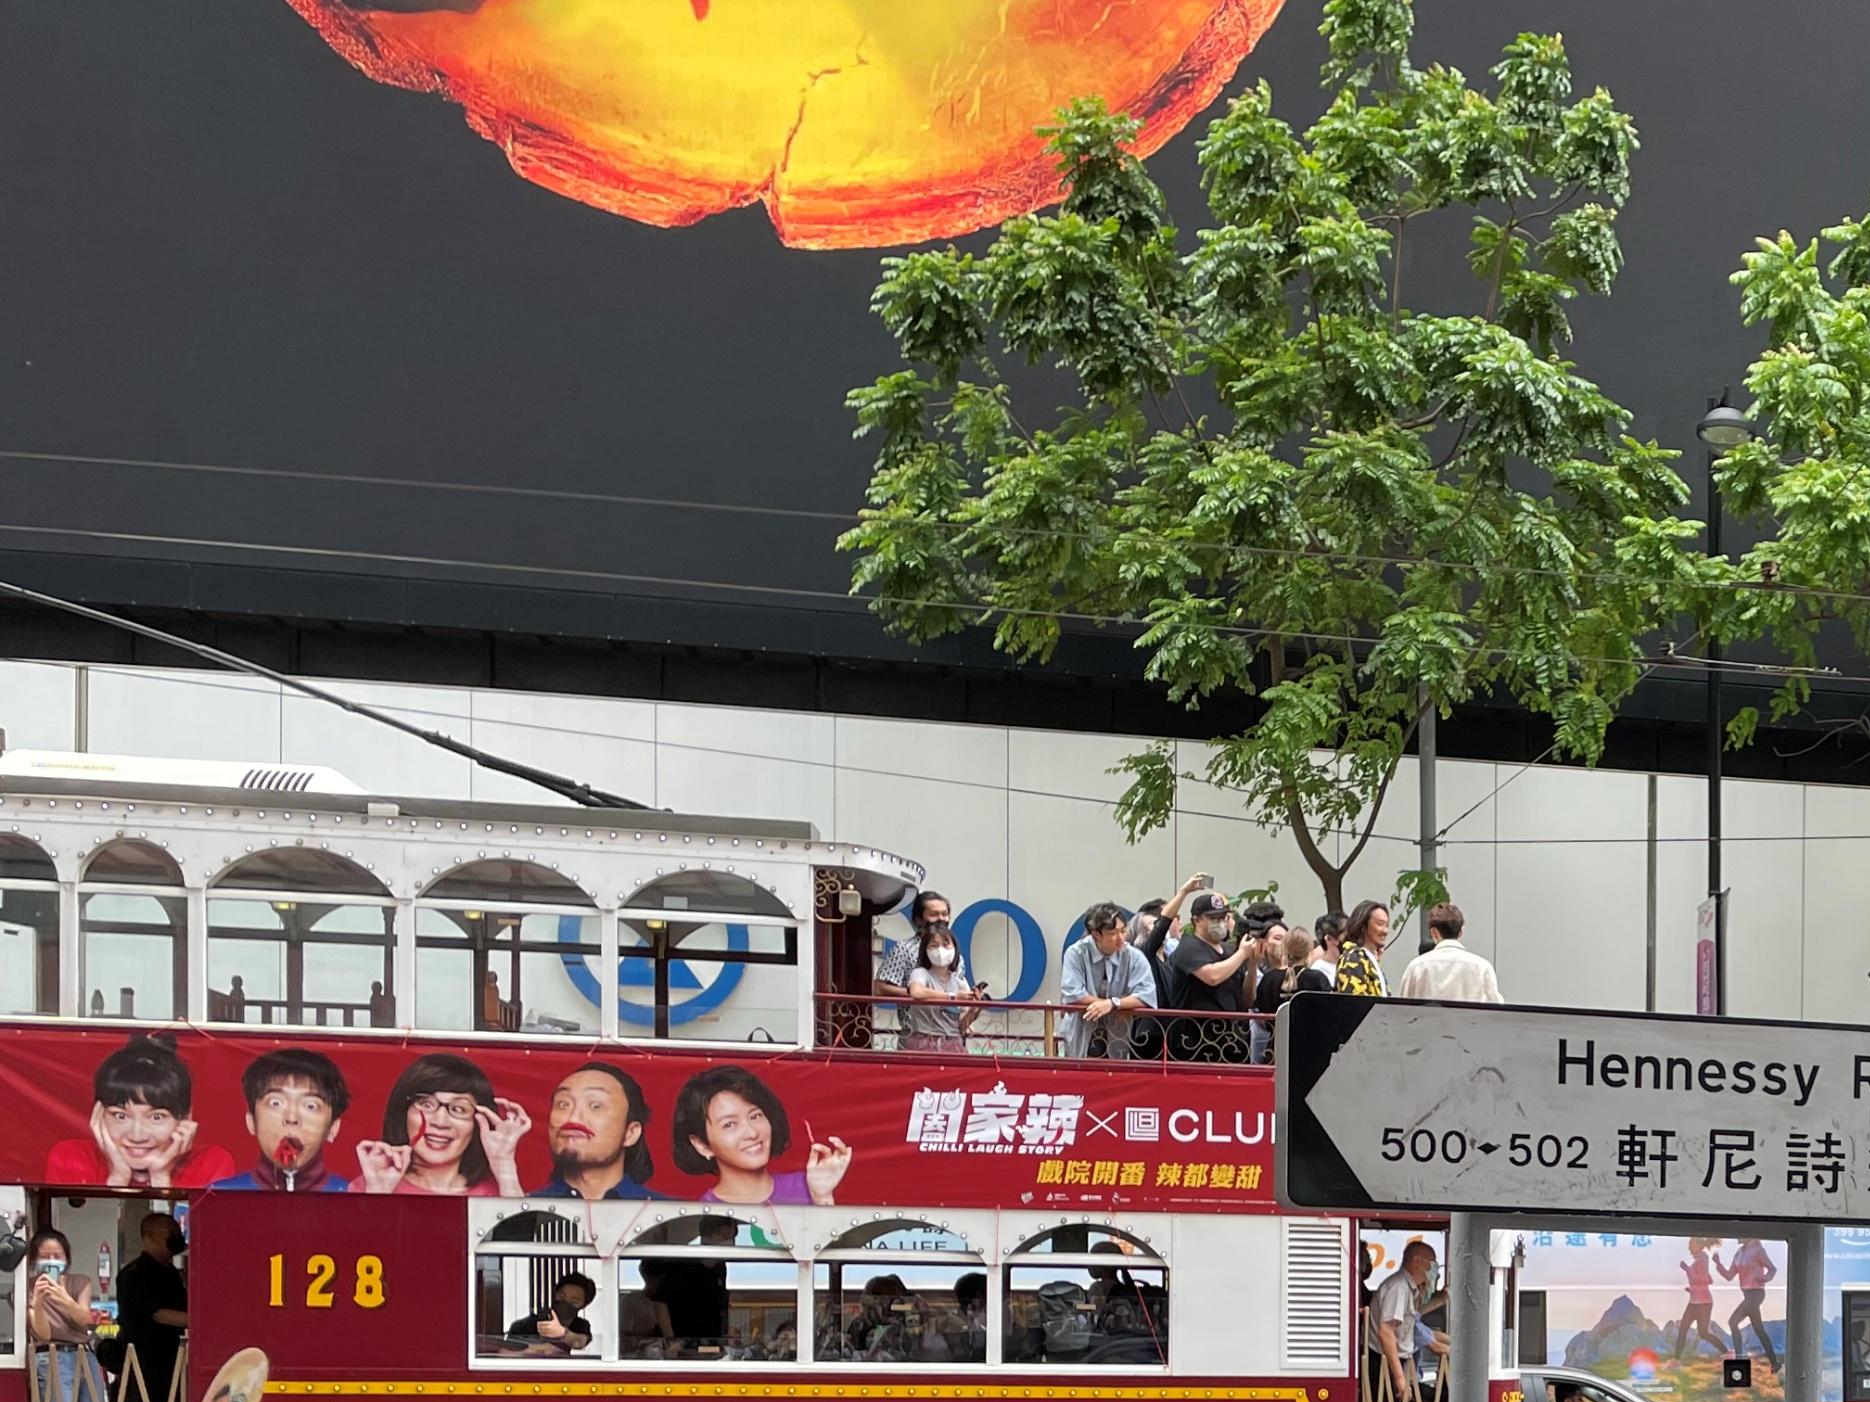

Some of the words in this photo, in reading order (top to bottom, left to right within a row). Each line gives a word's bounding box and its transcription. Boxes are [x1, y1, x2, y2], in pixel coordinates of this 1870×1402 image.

[1558, 1039, 1820, 1105] Hennessy
[1168, 1108, 1276, 1144] CLU
[919, 1142, 963, 1153] CHILLI
[968, 1143, 1014, 1155] LAUGH
[1018, 1145, 1064, 1155] STORY
[1381, 1127, 1467, 1163] 500
[1508, 1134, 1590, 1169] 502
[1037, 1159, 1146, 1187] 戲院開番
[1155, 1162, 1263, 1190] 辣都變甜
[269, 1253, 386, 1308] 128
